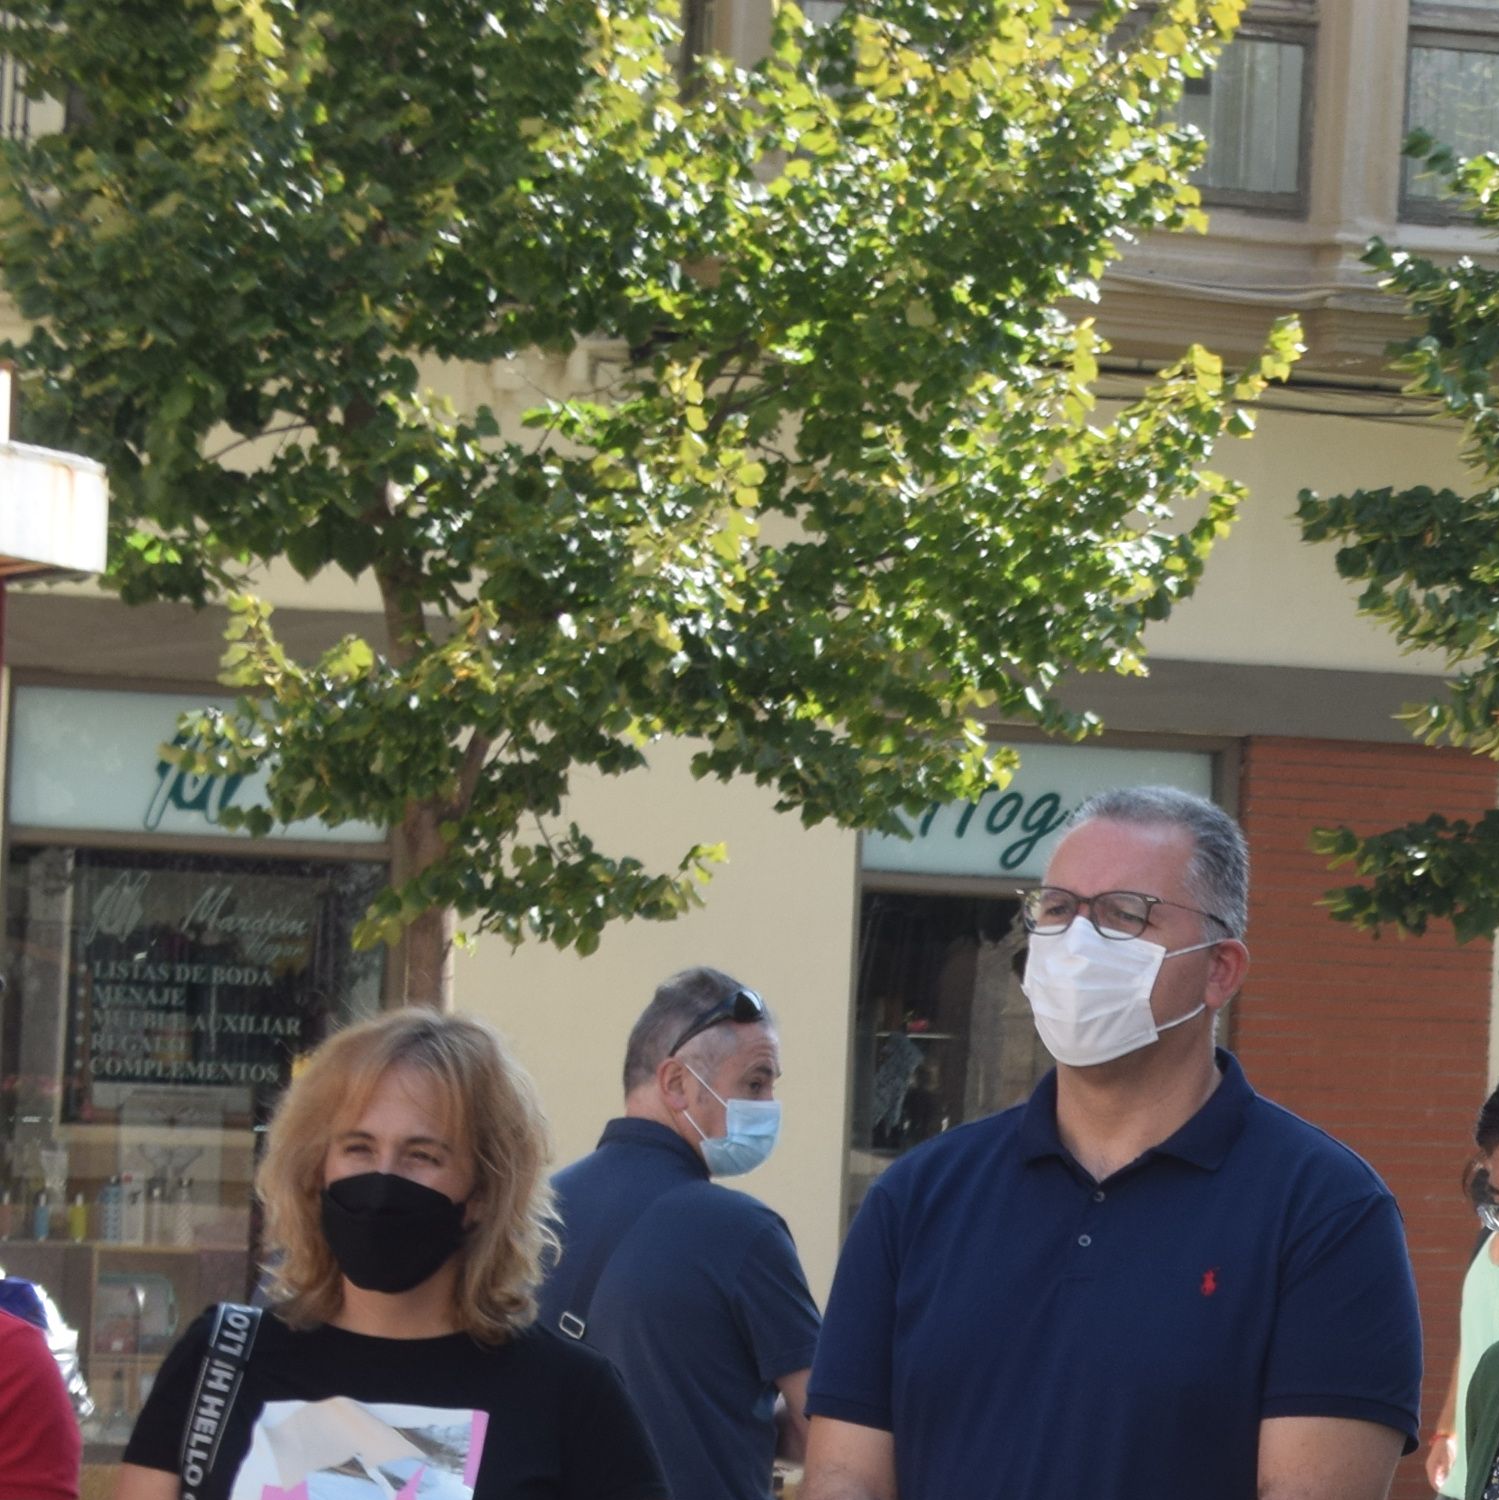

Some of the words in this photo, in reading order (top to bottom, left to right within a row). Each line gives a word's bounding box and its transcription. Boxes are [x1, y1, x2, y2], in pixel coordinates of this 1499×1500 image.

[93, 960, 169, 982] LISTAS
[175, 963, 207, 983] DE
[211, 966, 273, 987] BODA
[93, 985, 187, 1005] MENAJE
[191, 1014, 302, 1036] AUXILIAR
[89, 1056, 279, 1082] COMPLEMENTOS
[183, 1397, 225, 1487] HELLO
